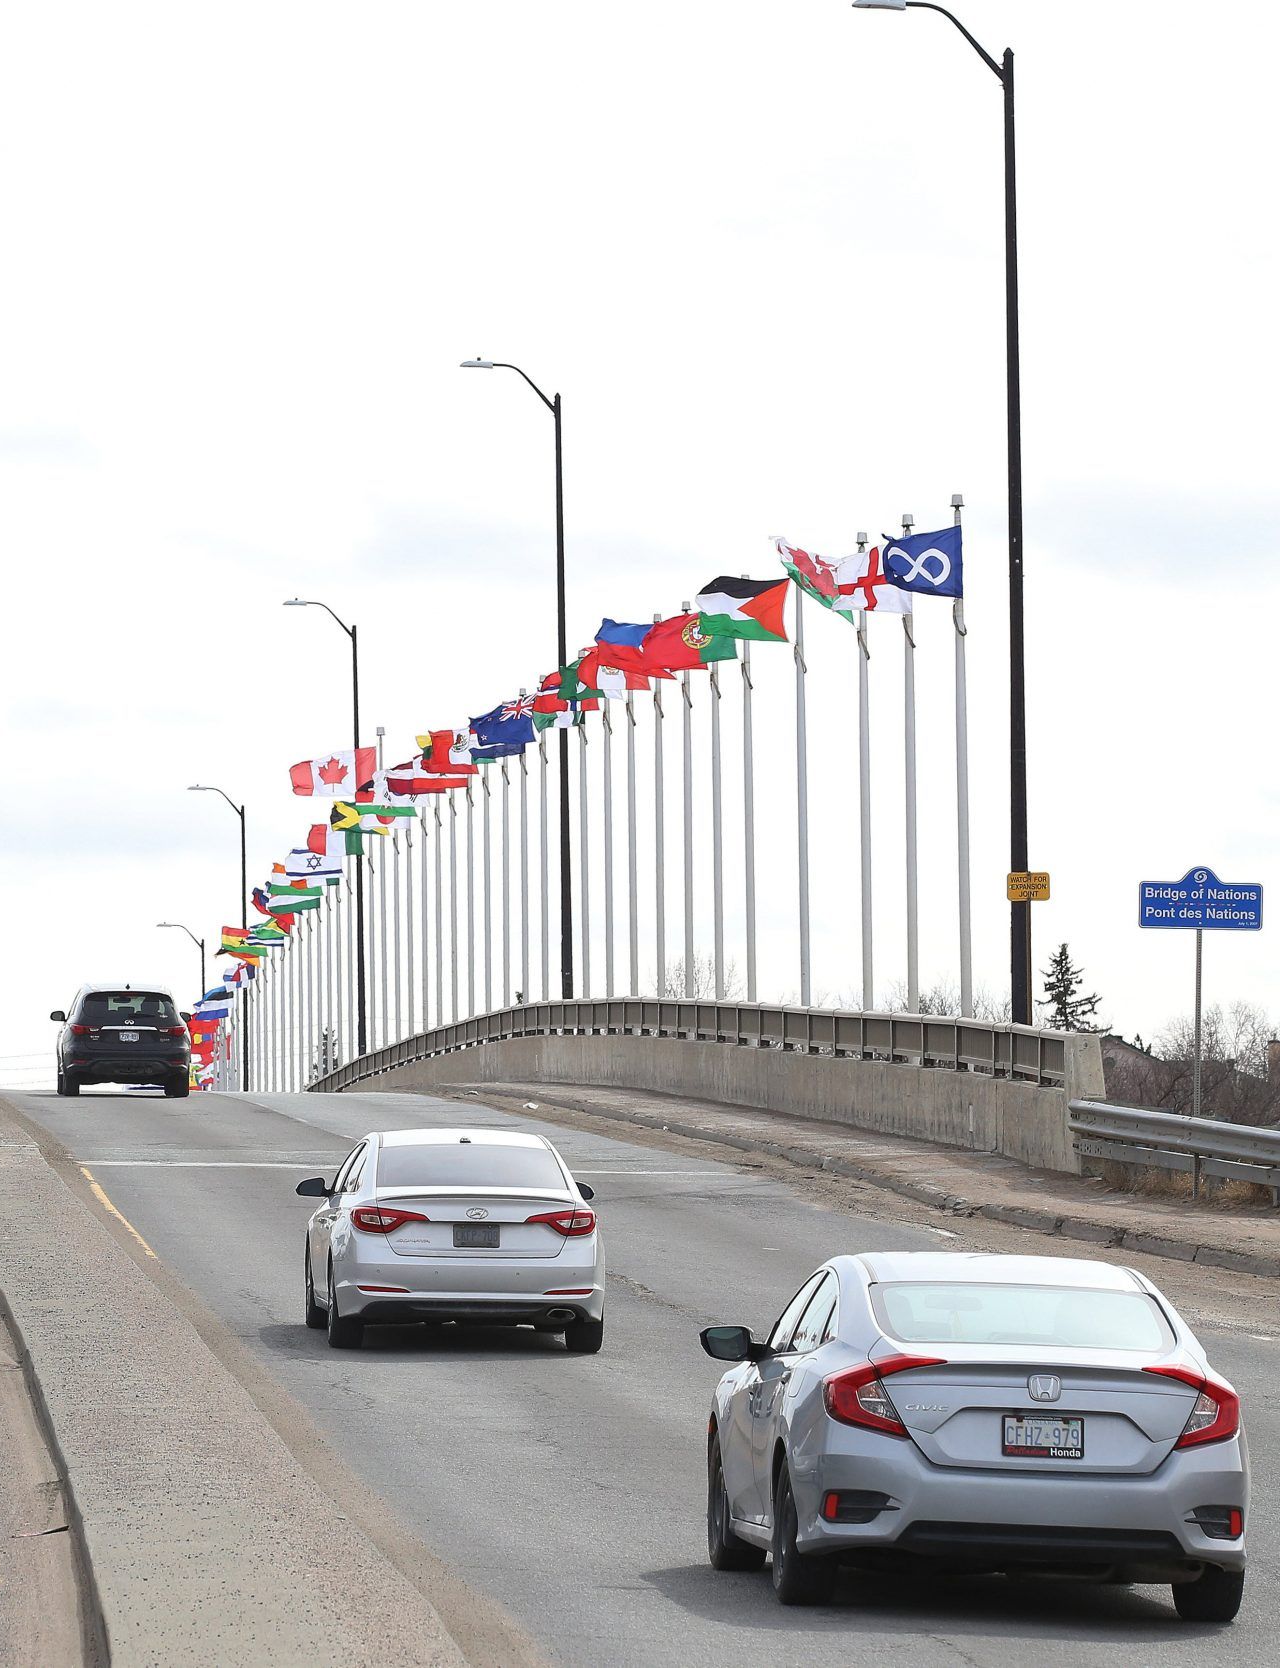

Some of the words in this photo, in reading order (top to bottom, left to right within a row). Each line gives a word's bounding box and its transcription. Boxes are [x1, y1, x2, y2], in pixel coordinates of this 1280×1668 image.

[1145, 887, 1187, 901] Bridge
[1191, 888, 1204, 899] of
[1208, 889, 1257, 900] Nations
[1145, 907, 1175, 918] Pont
[1179, 907, 1202, 919] des
[1206, 908, 1256, 920] Nations
[905, 1404, 949, 1412] CIVIC
[1006, 1426, 1043, 1446] CFHZ
[1053, 1428, 1080, 1447] 979
[1050, 1448, 1081, 1458] Honda
